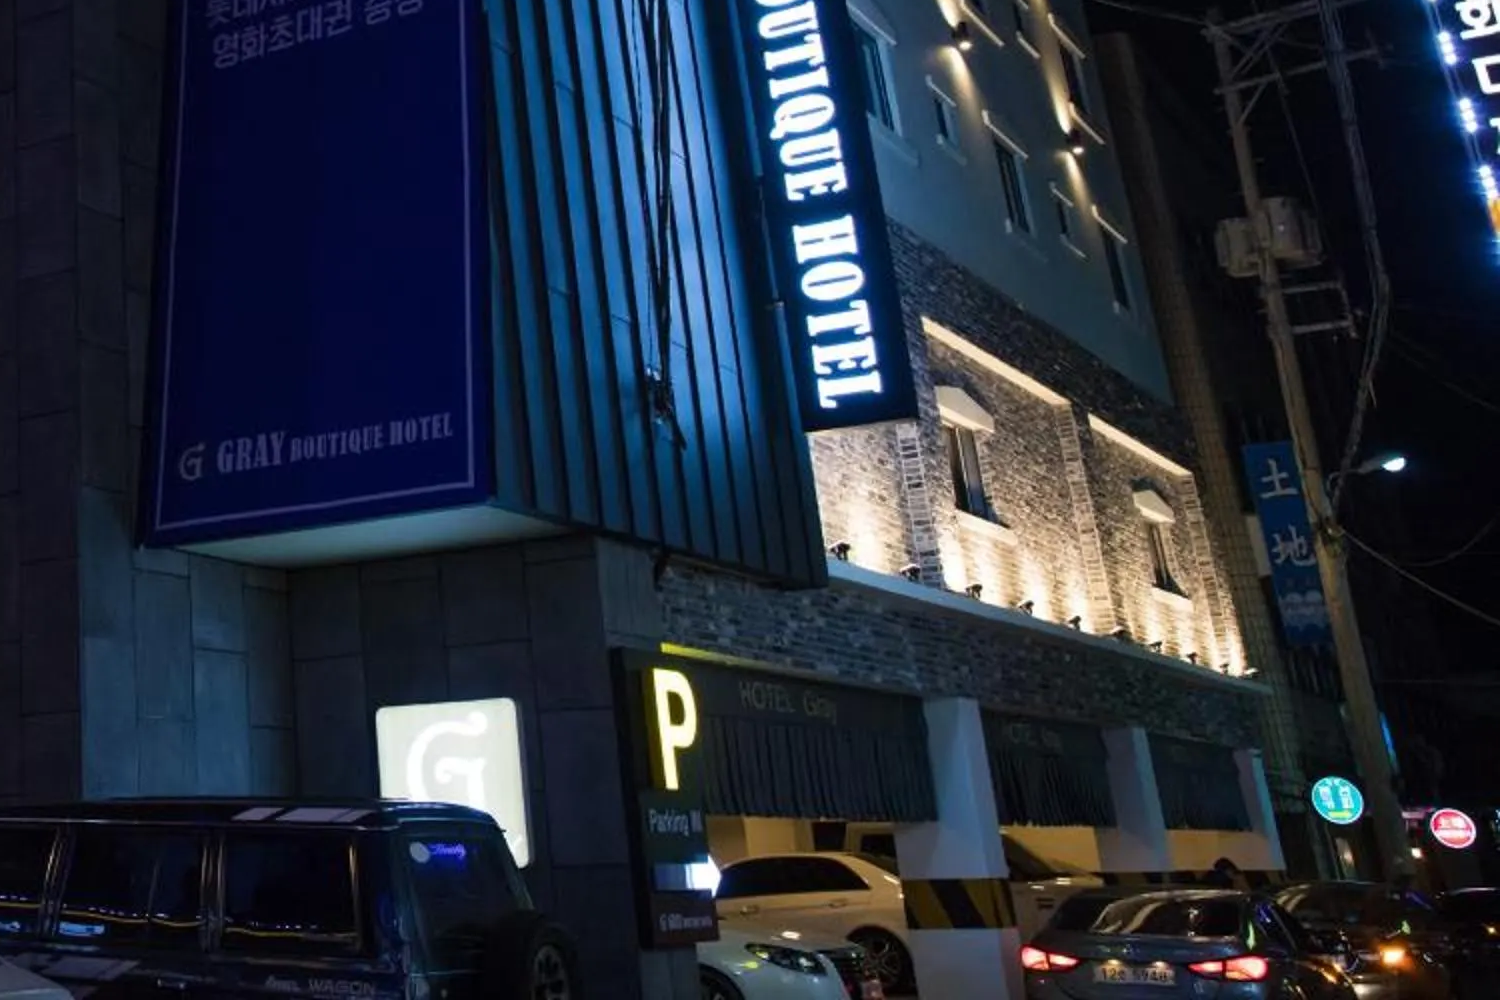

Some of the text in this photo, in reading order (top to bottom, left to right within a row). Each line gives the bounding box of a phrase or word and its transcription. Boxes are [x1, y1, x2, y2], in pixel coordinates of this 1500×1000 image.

[792, 214, 883, 409] HOTEL
[216, 430, 288, 475] GRAY
[290, 423, 384, 464] BOUTIQUE
[389, 412, 454, 447] HOTEL
[1259, 457, 1316, 567] 土地
[652, 667, 698, 791] P
